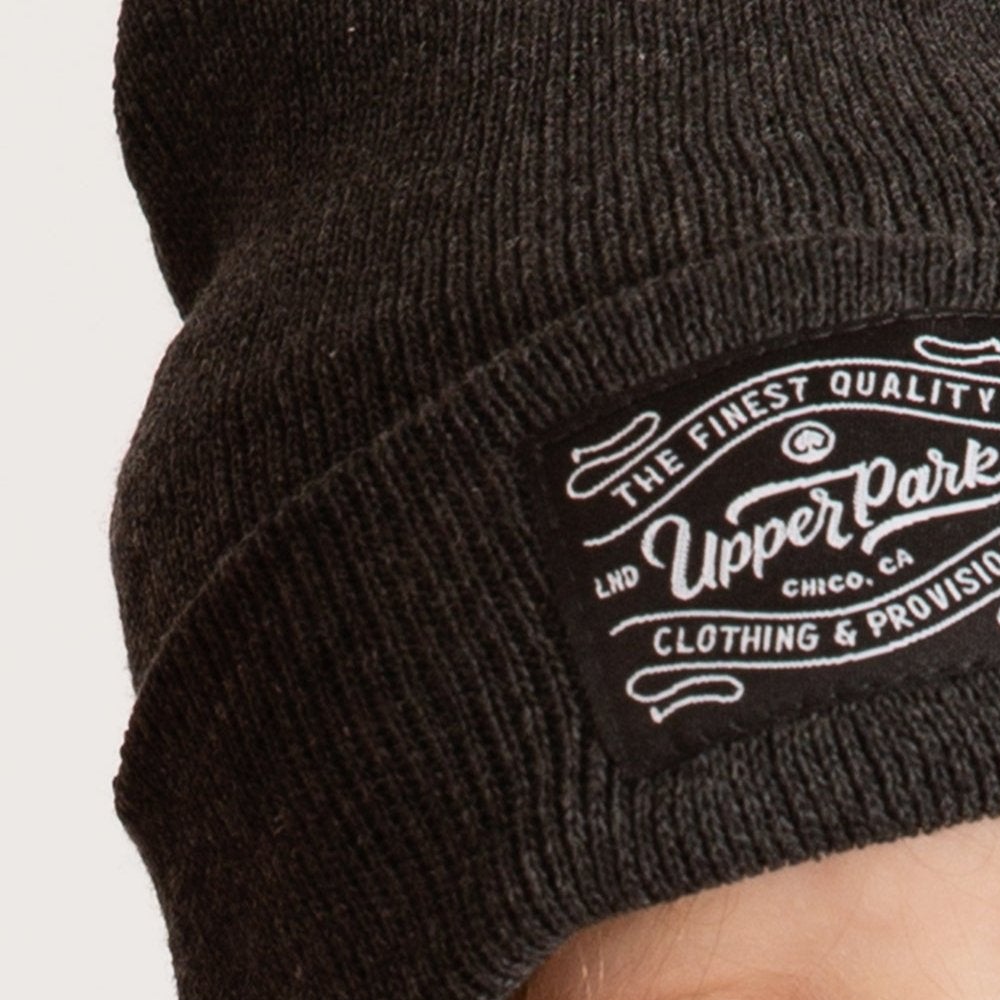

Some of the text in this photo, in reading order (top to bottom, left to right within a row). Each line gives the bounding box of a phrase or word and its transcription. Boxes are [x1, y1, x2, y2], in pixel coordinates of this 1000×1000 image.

[610, 370, 996, 507] THE FINEST QUALITY
[640, 487, 854, 601] Upper
[877, 548, 915, 576] CA
[594, 565, 640, 599] LND
[653, 622, 820, 657] CLOTHING
[833, 619, 858, 647] &
